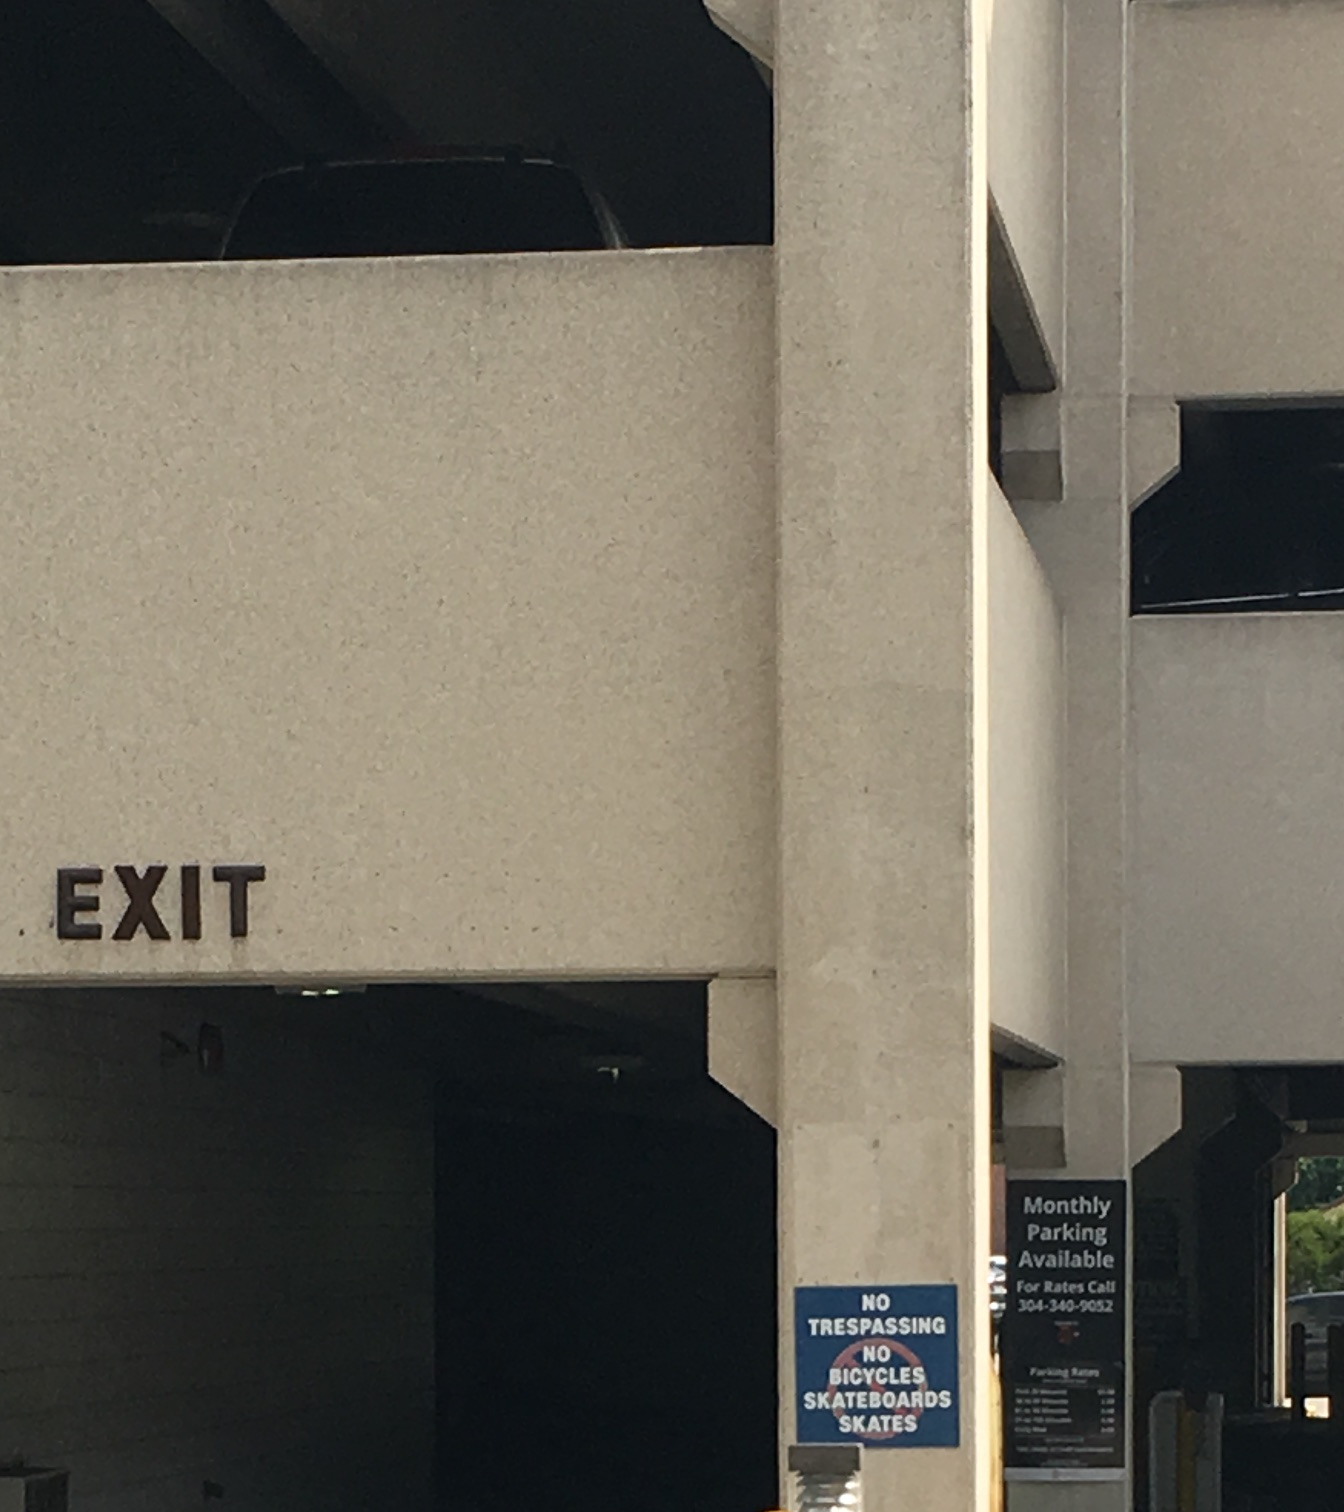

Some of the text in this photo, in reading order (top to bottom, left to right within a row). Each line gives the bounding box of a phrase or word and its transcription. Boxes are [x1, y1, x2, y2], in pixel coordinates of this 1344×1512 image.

[56, 864, 266, 941] EXIT
[1023, 1195, 1111, 1219] Monthly
[1027, 1222, 1107, 1246] Parking
[1018, 1249, 1115, 1269] Available
[1016, 1280, 1116, 1294] For Rates Call
[861, 1294, 891, 1311] NO
[808, 1316, 946, 1336] TRESPASSING
[862, 1345, 891, 1362] NO
[829, 1366, 926, 1385] BICYCLES
[803, 1390, 952, 1410] SKATEBOARDS
[838, 1415, 918, 1433] SKATES
